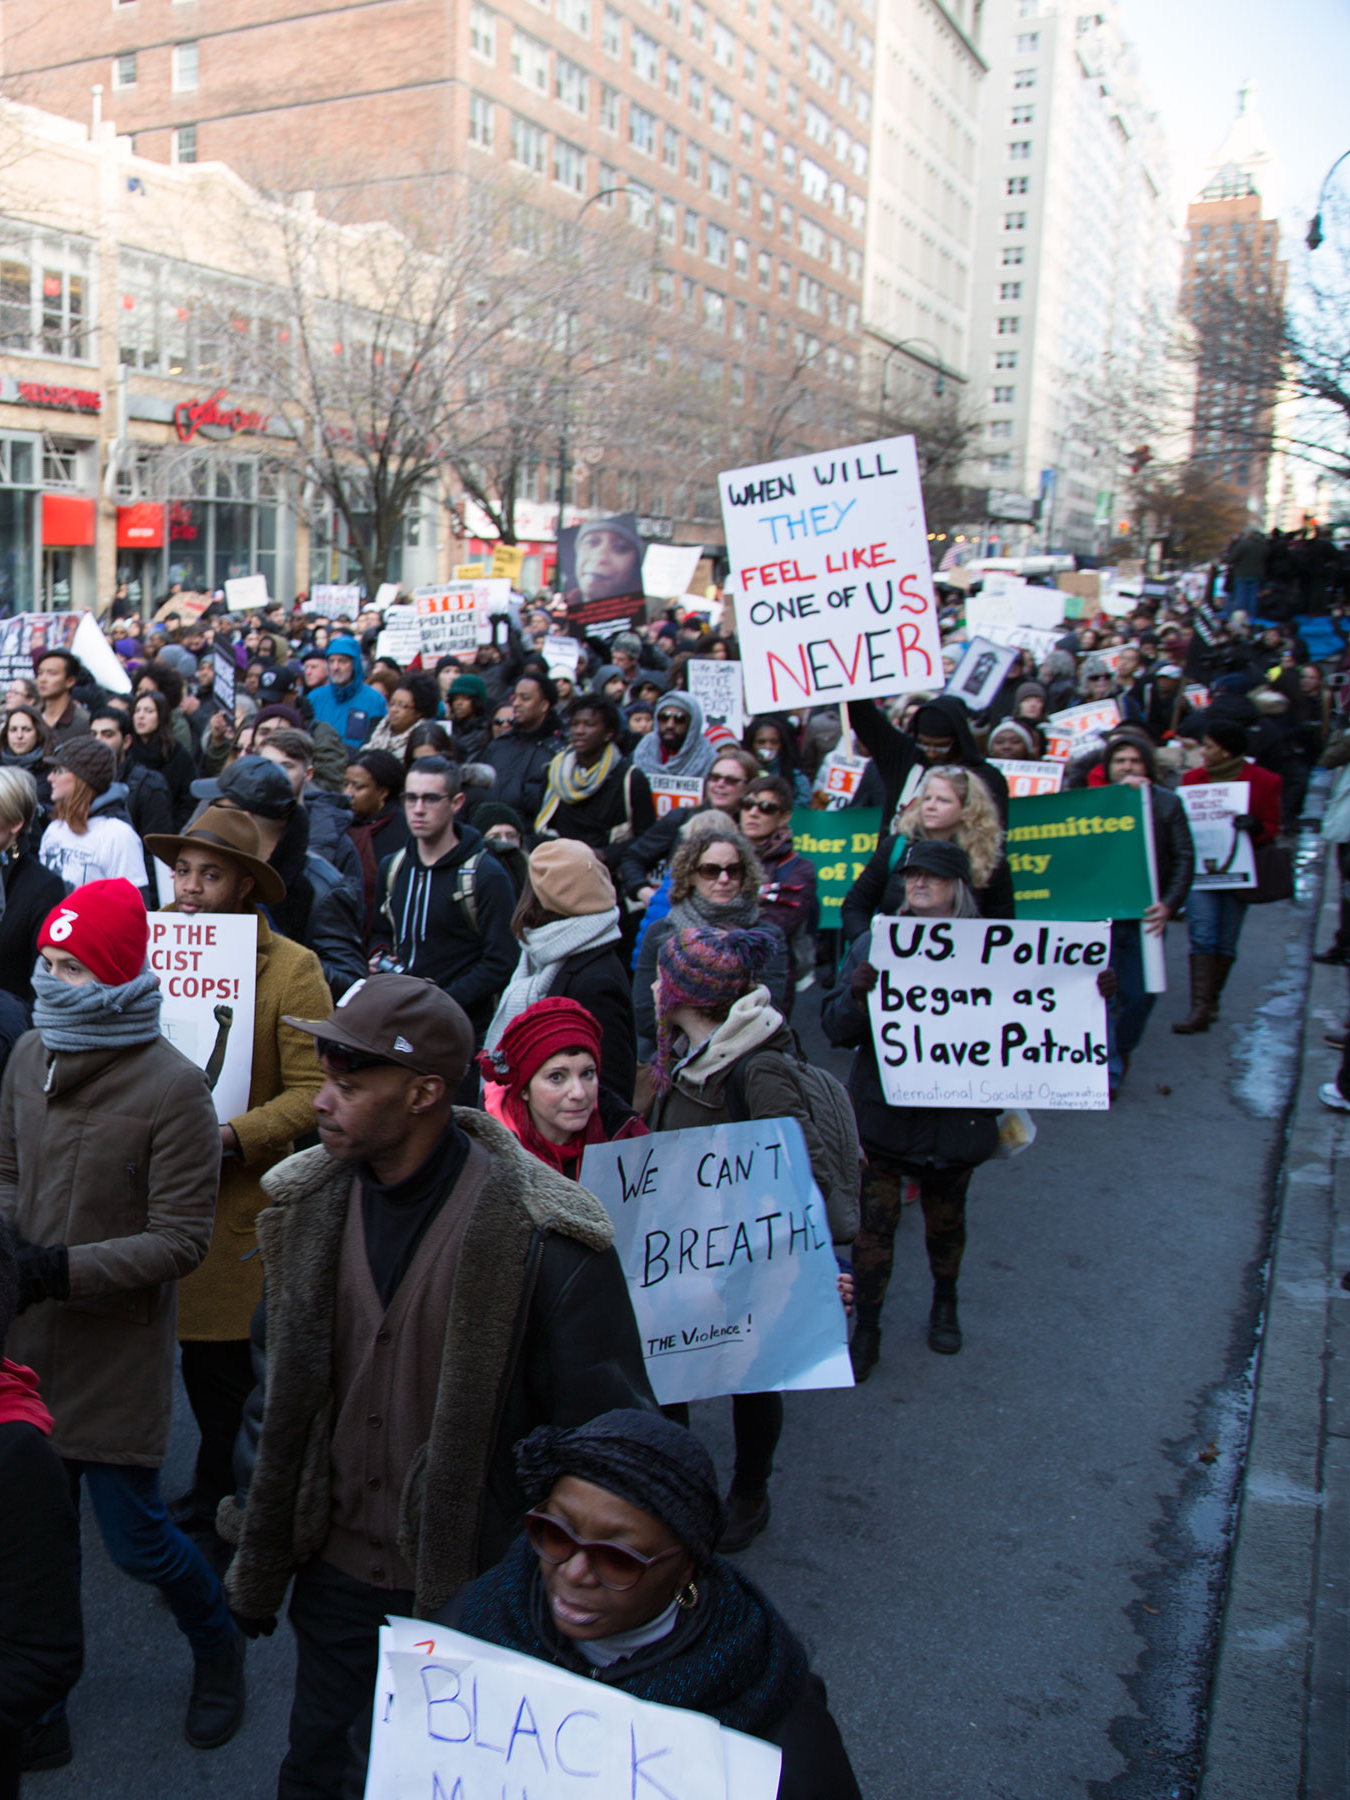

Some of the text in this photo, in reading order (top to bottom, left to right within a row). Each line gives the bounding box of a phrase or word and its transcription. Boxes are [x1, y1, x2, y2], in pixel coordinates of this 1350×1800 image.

[729, 453, 898, 506] WHEN WILL
[758, 498, 857, 544] THEY
[741, 542, 896, 592] FEEL LIKE
[419, 612, 474, 627] POLICE
[750, 574, 929, 626] ONE OF US
[766, 622, 932, 703] NEVER
[1014, 777, 1056, 797] OP
[1007, 854, 1052, 874] ity
[173, 923, 217, 946] THE
[888, 922, 1107, 966] U.S. Police
[150, 949, 203, 972] CIST
[168, 976, 240, 1001] COPS!
[880, 969, 1057, 1016] began as
[880, 1021, 1109, 1067] Slave Patrols
[616, 1141, 782, 1204] WE CAN'T
[640, 1204, 826, 1288] BREATHE
[647, 1335, 677, 1355] THE
[419, 1663, 680, 1800] BLACK
